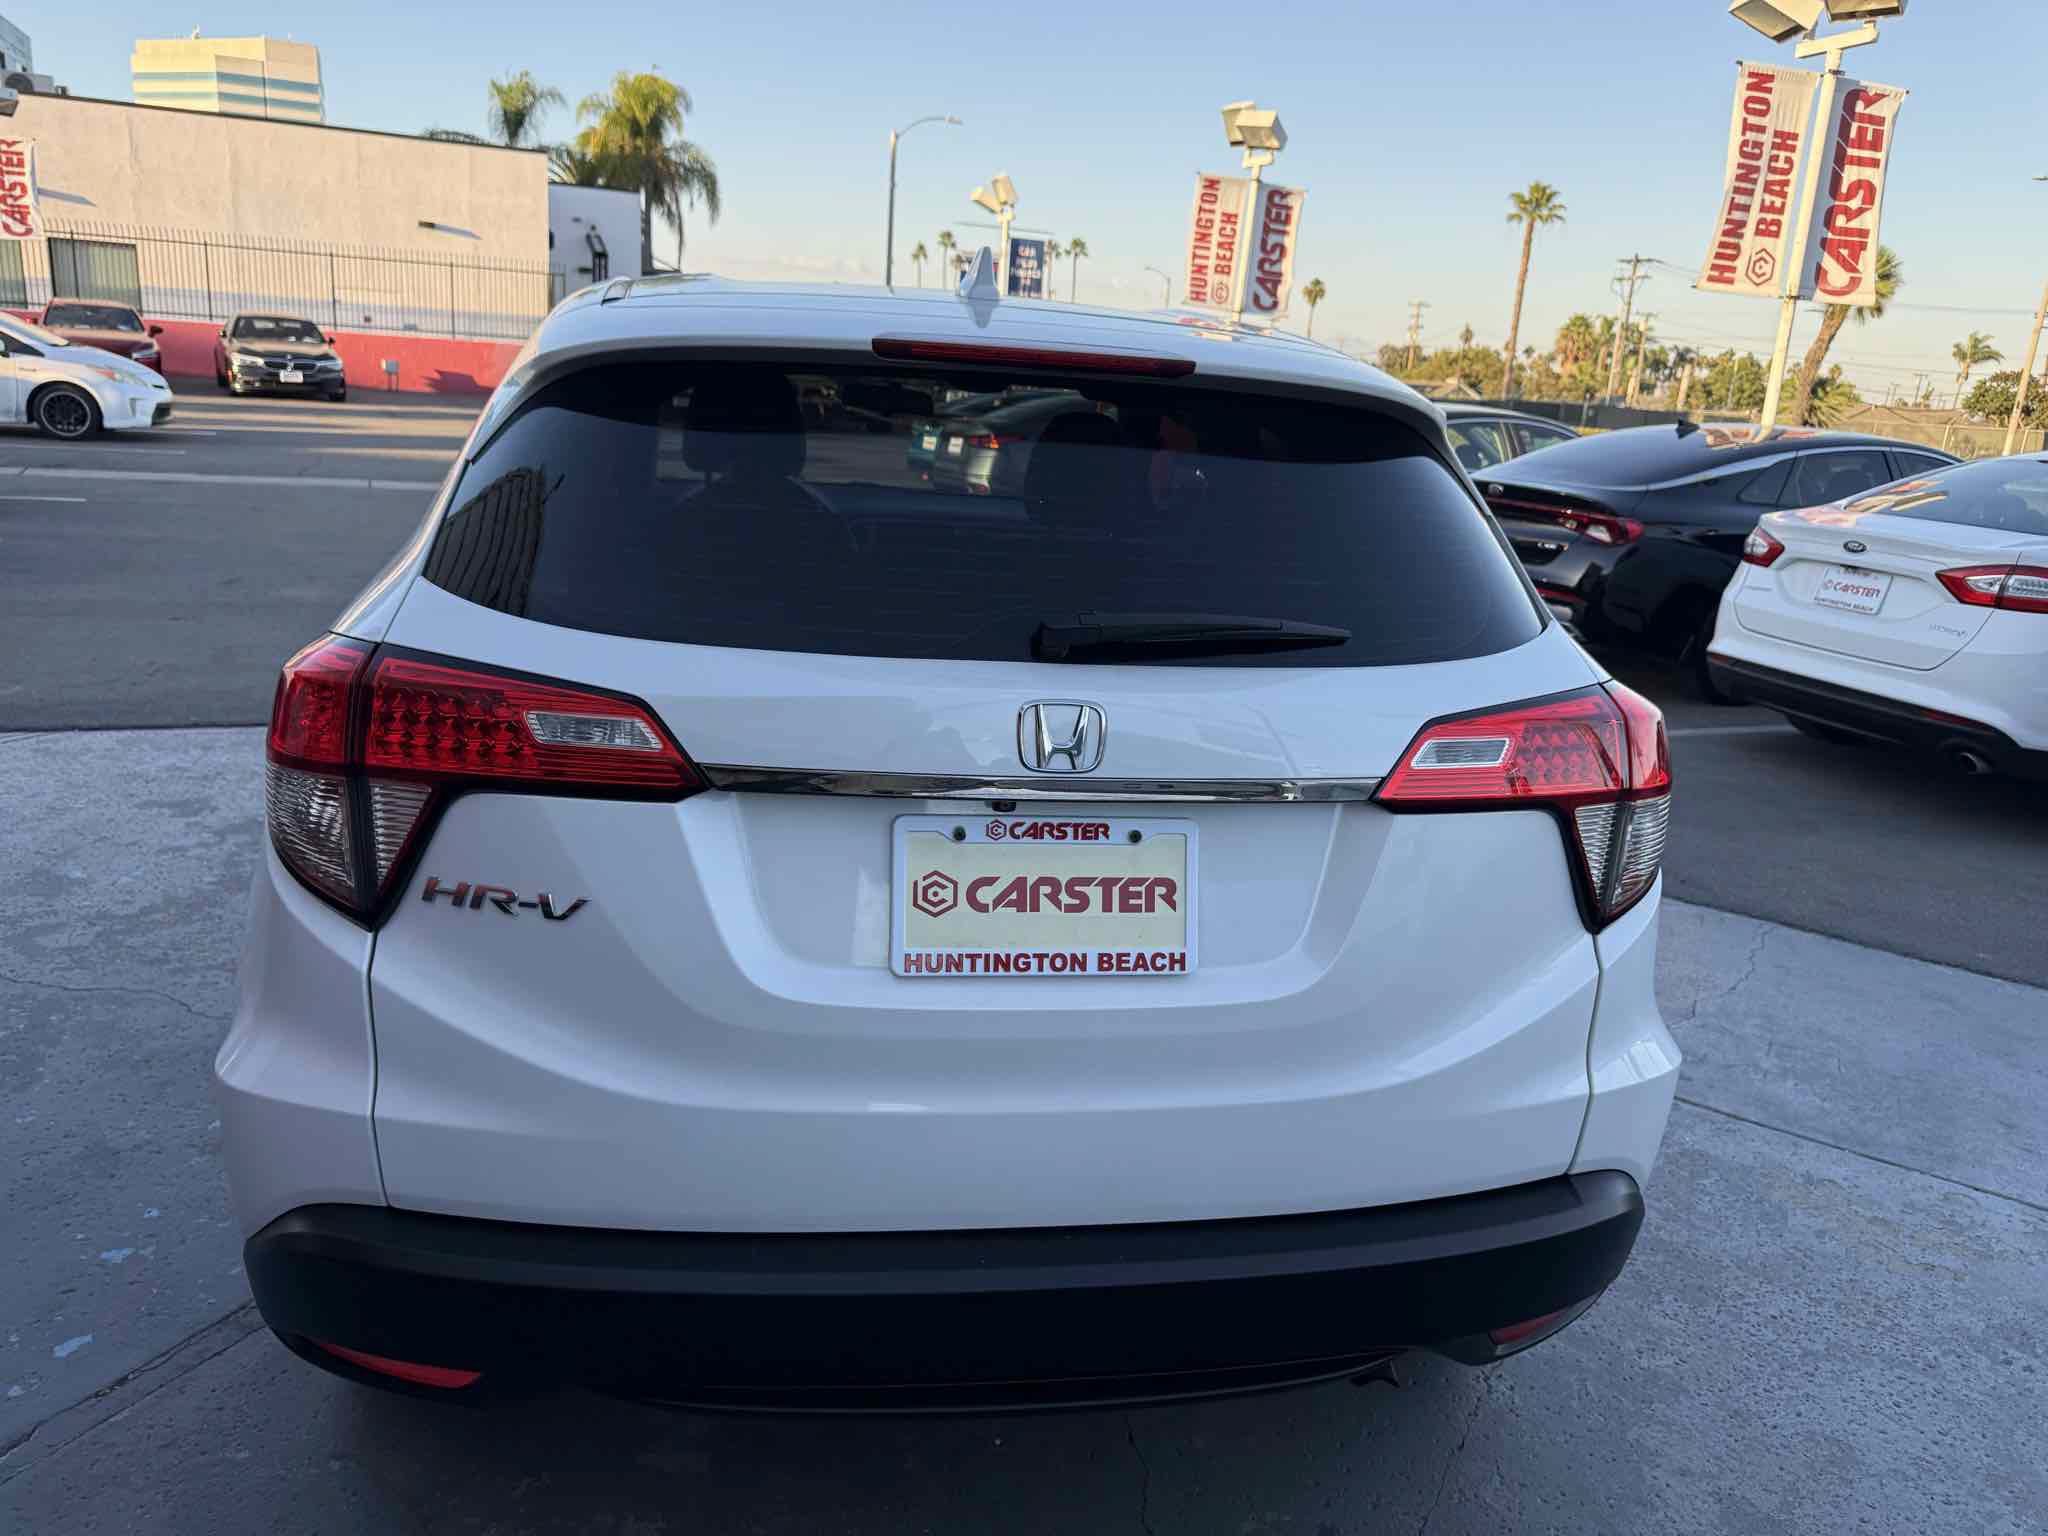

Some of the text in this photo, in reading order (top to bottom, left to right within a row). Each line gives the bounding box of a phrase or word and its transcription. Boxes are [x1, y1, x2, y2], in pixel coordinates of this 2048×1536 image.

[1707, 71, 1777, 286] HUNTINGTON
[1754, 129, 1799, 240] BEACH
[1814, 87, 1891, 297] CARSTER
[1190, 177, 1221, 303] HUNTINGTON
[1214, 212, 1239, 277] BEACH
[1253, 188, 1294, 311] CARSTER
[1833, 580, 1881, 598] CARSTER
[1009, 821, 1111, 841] CARSTER
[421, 875, 592, 921] HR-V
[965, 875, 1177, 914] CARSTER
[903, 951, 1187, 974] HUNTINGTON BEACH
